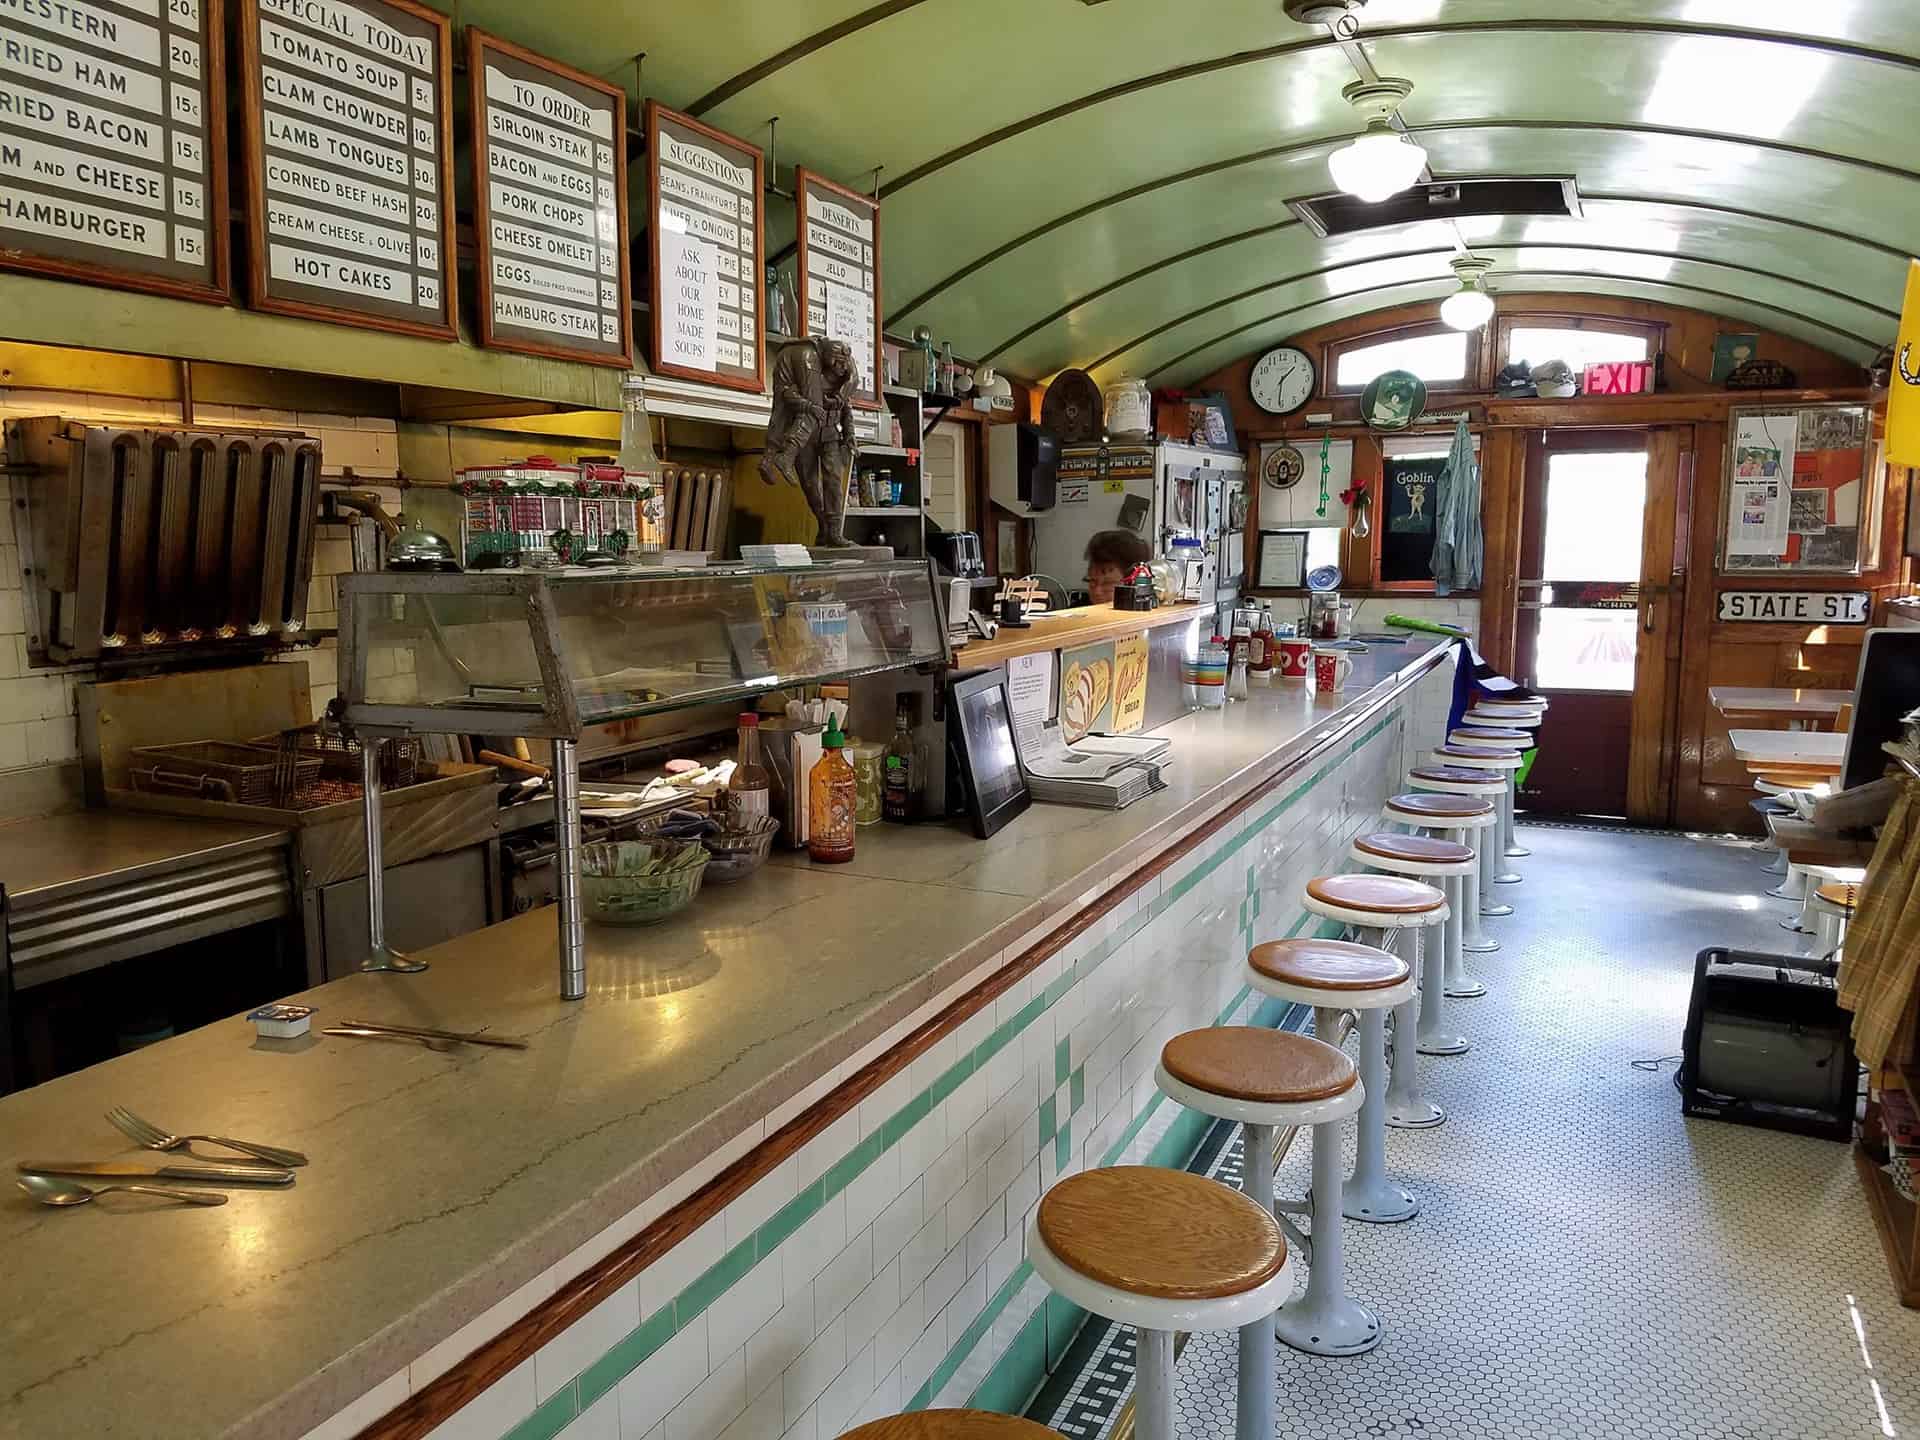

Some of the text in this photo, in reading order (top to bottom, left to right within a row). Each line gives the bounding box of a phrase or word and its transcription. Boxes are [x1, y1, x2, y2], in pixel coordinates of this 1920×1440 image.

[270, 31, 348, 73] TOMATO
[356, 64, 399, 91] SOUP
[364, 24, 428, 66] TODAY
[0, 37, 63, 73] RIED
[76, 62, 127, 95] HAM
[264, 76, 315, 106] CLAM
[323, 96, 406, 137] CHOWDER
[513, 84, 591, 129] TO ORDER
[67, 109, 148, 148] BACON
[493, 115, 545, 145] SIRLOIN
[549, 135, 588, 159] STEAK
[270, 119, 320, 149] LAMB
[327, 138, 404, 175] TONGUES
[33, 160, 65, 177] AND
[76, 164, 160, 199] CHEESE
[490, 152, 537, 178] BACON
[542, 173, 559, 185] AND
[561, 174, 592, 195] EGGS
[670, 143, 745, 186] SUGGESTIONS
[268, 166, 330, 193] CORNED
[336, 184, 367, 203] BEEF
[372, 194, 408, 214] HASH
[661, 175, 686, 194] BEANS
[690, 187, 738, 212] FRANKFURTS
[0, 198, 146, 243] HAMBURGER
[502, 192, 585, 226] PORK CHOPS
[821, 206, 860, 233] DESSERTS
[267, 211, 315, 233] CREAM
[319, 223, 366, 244] CHEESE
[377, 237, 411, 255] OLIVE
[494, 226, 543, 250] CHEESE
[547, 240, 593, 262] OMELET
[701, 219, 735, 241] ONIONS
[811, 230, 827, 245] RICE
[828, 236, 858, 257] PUDDING
[681, 247, 701, 265] ASK
[724, 257, 737, 272] PIE
[826, 263, 846, 278] JELLO
[294, 257, 331, 279] HOT
[339, 267, 392, 291] CAKES
[496, 263, 532, 284] EGGS
[675, 264, 708, 285] ABOUT
[681, 285, 701, 302] OUR
[495, 301, 557, 325] HAMBURG
[560, 313, 598, 333] STEAK
[677, 302, 705, 321] HOME
[717, 315, 737, 330] RAVY
[677, 322, 705, 340] MADE
[1588, 363, 1652, 395] EXIT
[1396, 471, 1436, 485] Goblin
[1731, 595, 1857, 619] STATE ST.
